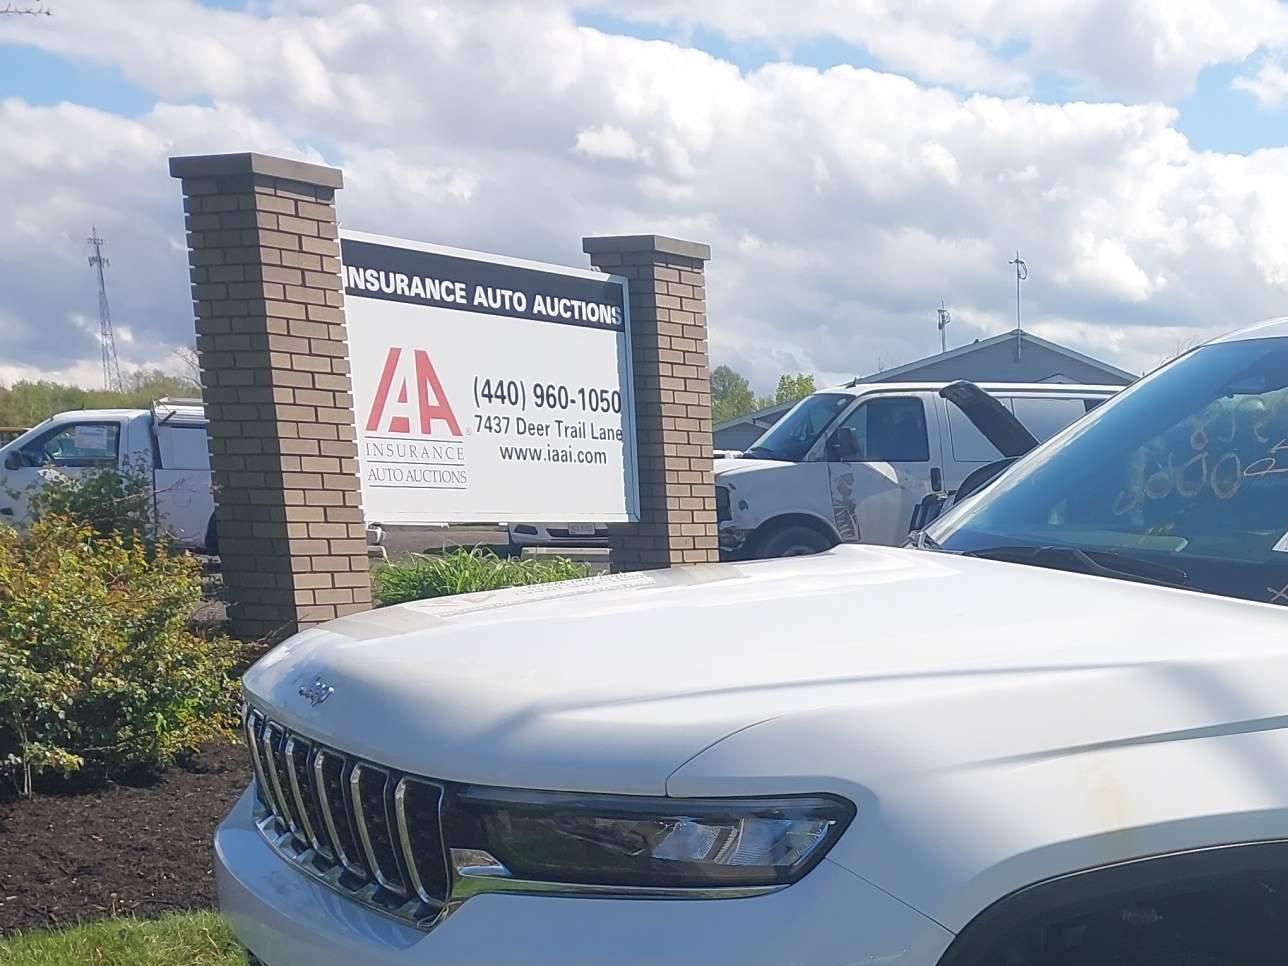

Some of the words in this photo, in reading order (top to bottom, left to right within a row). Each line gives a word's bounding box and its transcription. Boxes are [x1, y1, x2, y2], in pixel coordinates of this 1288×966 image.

[344, 265, 467, 304] INSURANCE
[473, 285, 527, 312] AUTO
[532, 294, 622, 325] AUCTIONS
[473, 375, 526, 411] (440)
[533, 383, 622, 414] 960-1050
[474, 414, 511, 435] 7437
[516, 417, 550, 438] Deer
[554, 419, 587, 440] Trail
[591, 422, 623, 442] Lane
[366, 442, 465, 461] INSURANCE
[499, 444, 608, 465] www.iaai.com
[368, 467, 403, 483] AUTO
[405, 468, 468, 485] AUCTIONS
